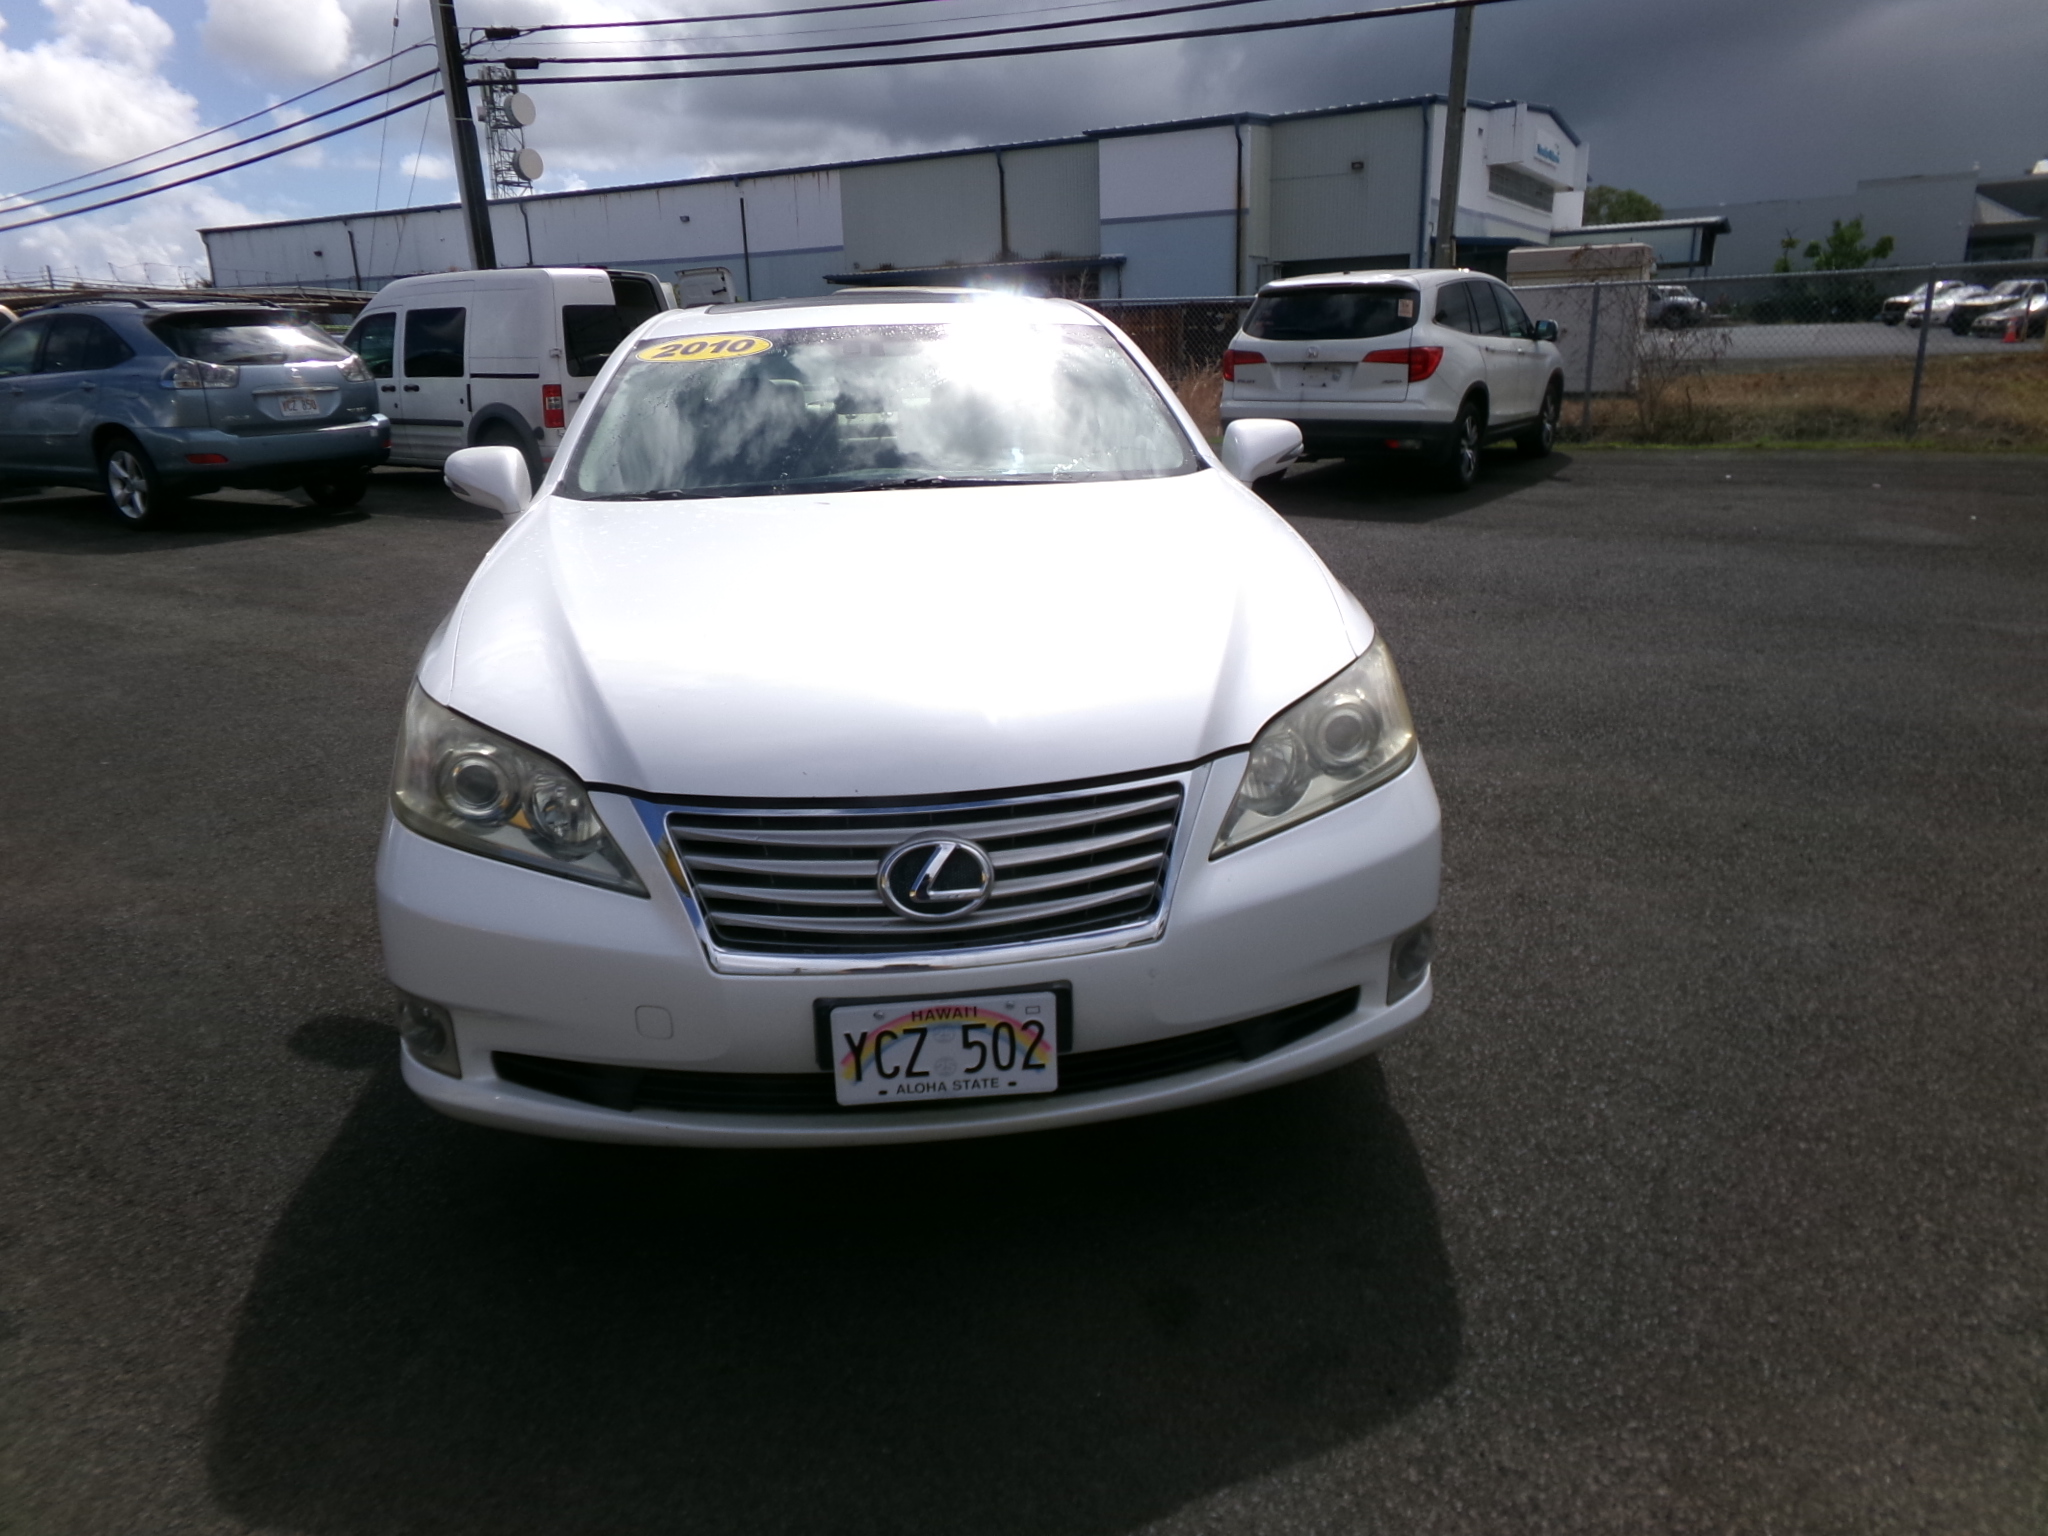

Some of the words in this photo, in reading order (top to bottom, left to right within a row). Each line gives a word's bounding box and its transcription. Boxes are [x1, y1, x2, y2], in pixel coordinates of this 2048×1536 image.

[650, 339, 756, 359] 2010
[844, 1027, 930, 1082] YCZ
[961, 1019, 1046, 1074] 502
[896, 1082, 947, 1095] ALOHA
[952, 1077, 1000, 1091] STATE
